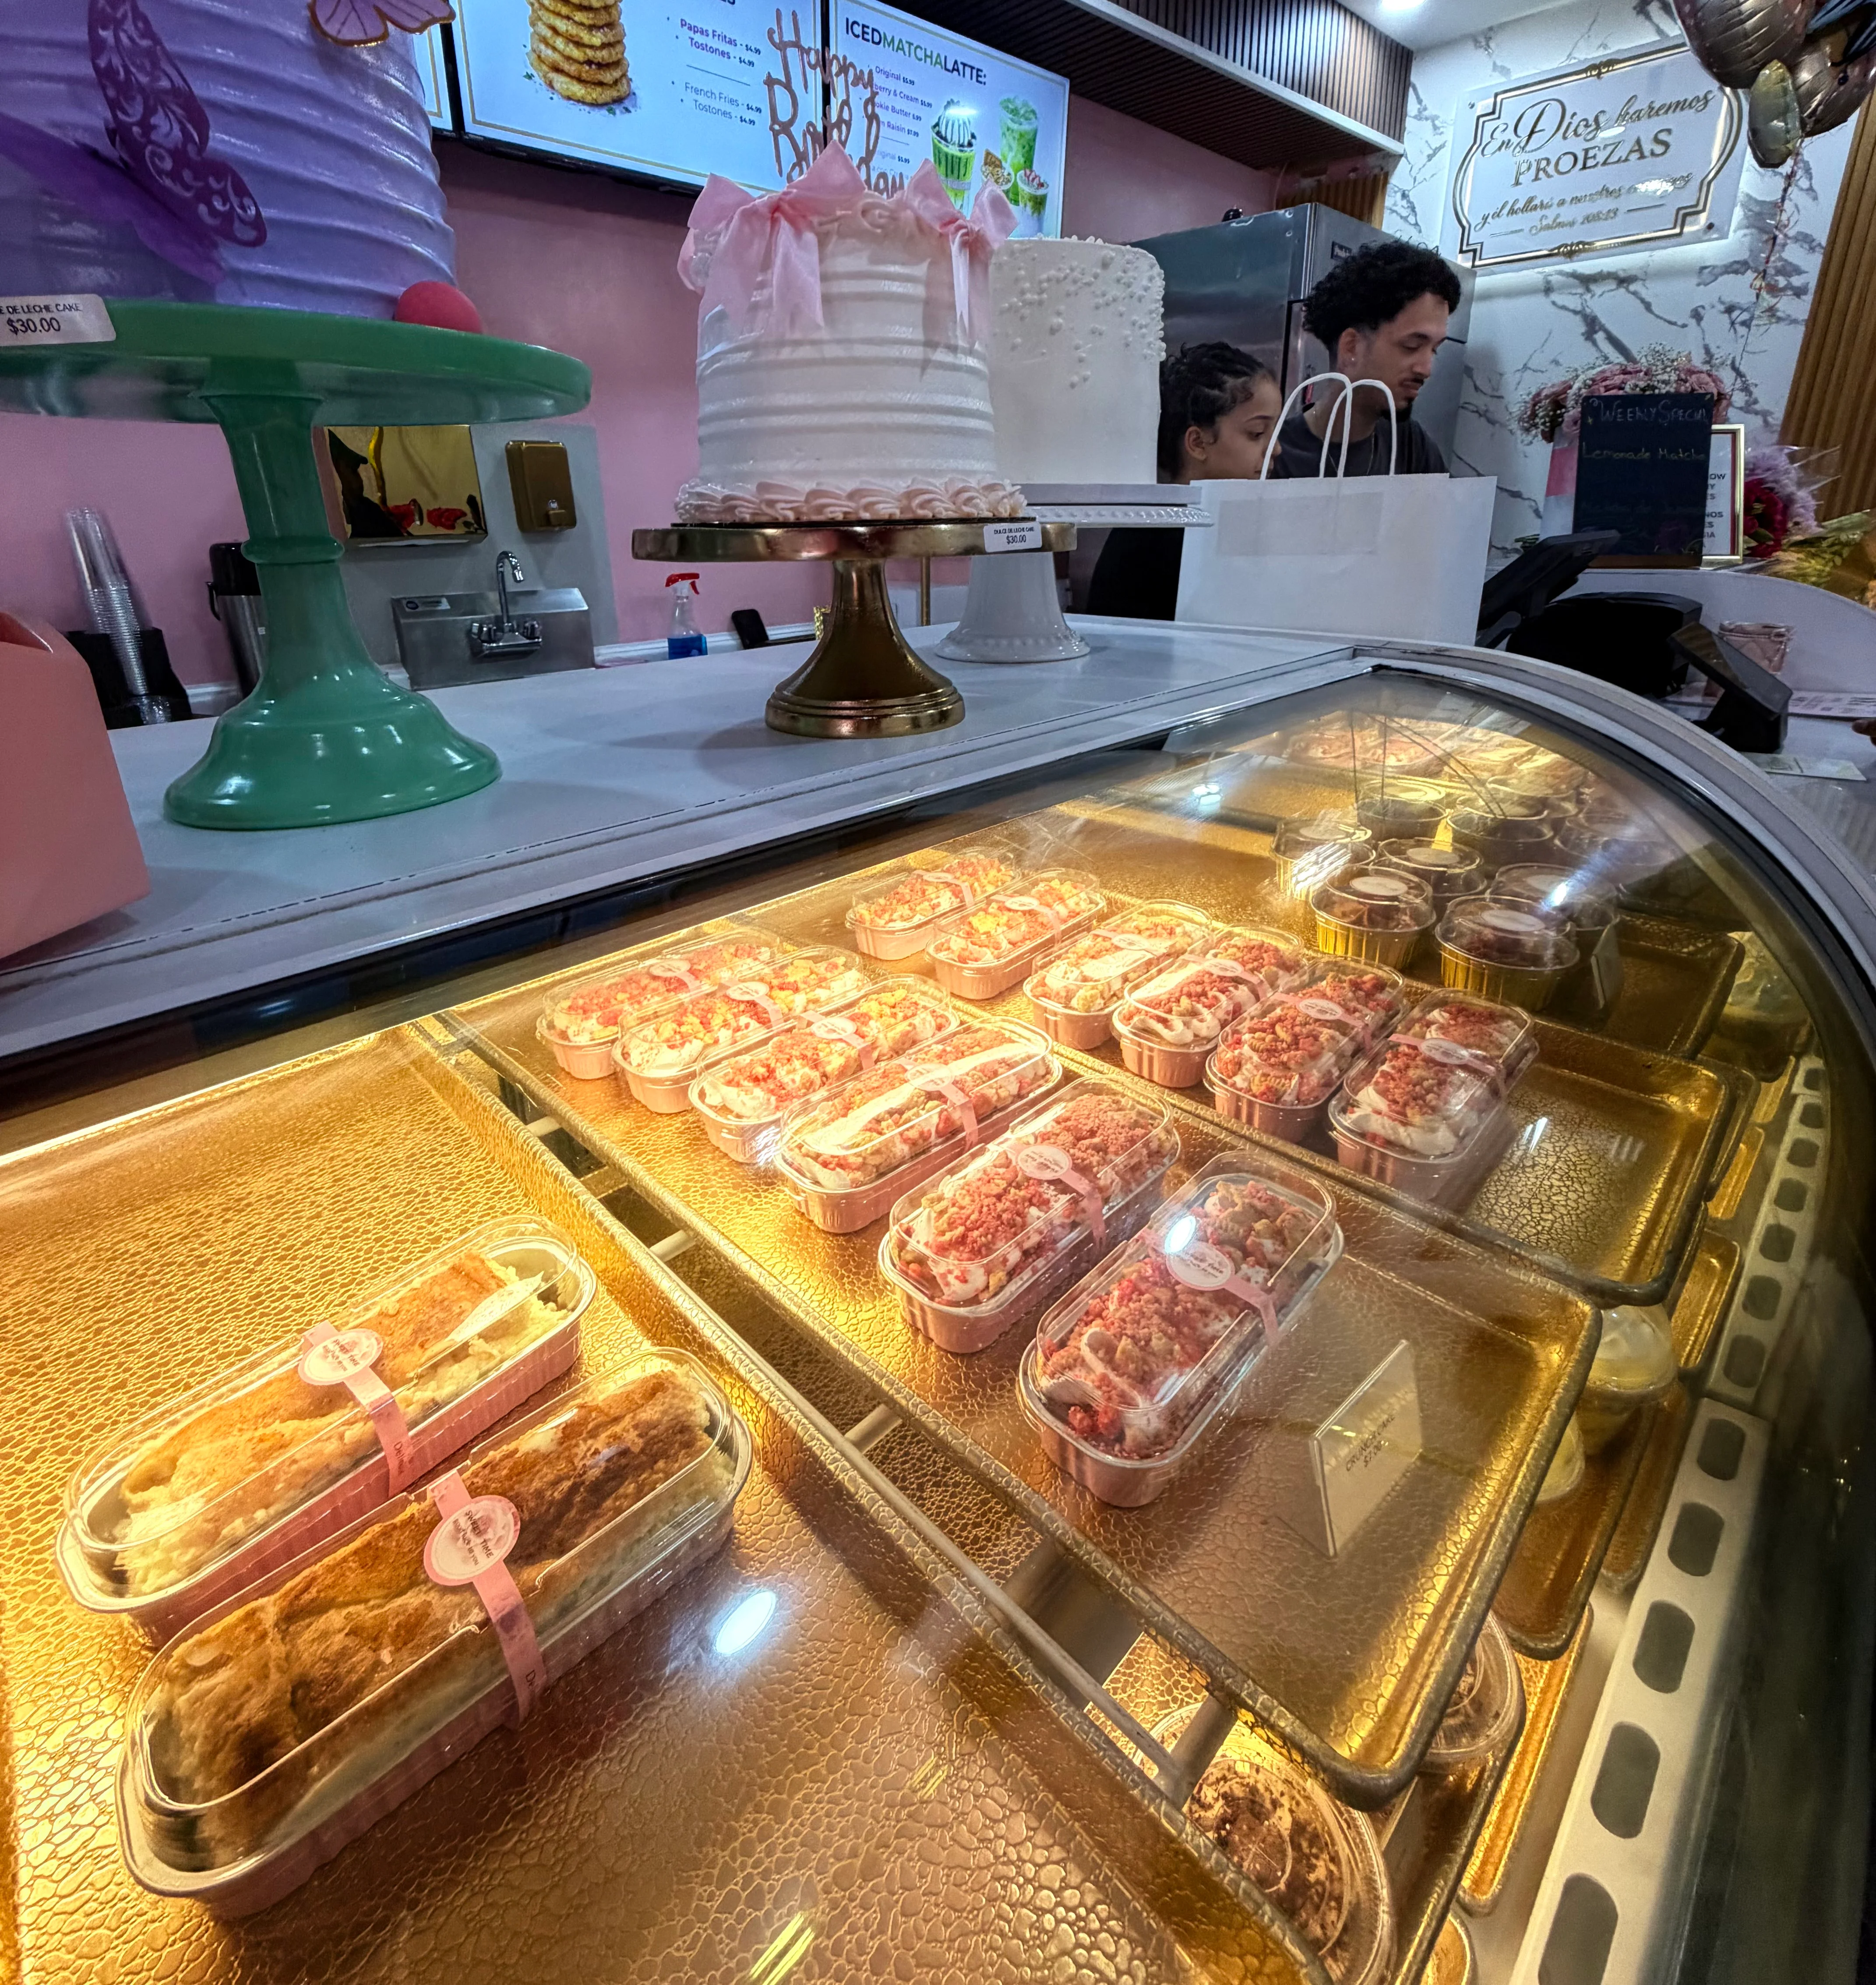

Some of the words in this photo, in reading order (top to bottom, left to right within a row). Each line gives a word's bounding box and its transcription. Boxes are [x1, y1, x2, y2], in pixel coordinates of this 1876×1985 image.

[680, 18, 709, 37] Papas
[712, 29, 737, 47] Fritas
[688, 36, 730, 60] Tostones
[875, 66, 901, 81] Original
[685, 82, 716, 100] French
[719, 92, 739, 107] Fries
[899, 91, 919, 104] Cream
[693, 99, 733, 119] Tostones
[891, 105, 911, 117] Butter
[887, 121, 906, 133] Raisin
[1481, 123, 1513, 158] En
[1512, 98, 1612, 158] Dios
[1614, 90, 1715, 127] haremos
[1511, 128, 1673, 187] PROEZAS
[1474, 212, 1491, 233] y
[1557, 198, 1566, 208] a
[55, 303, 82, 312] CAKE
[7, 317, 61, 336] $30.00
[1658, 399, 1708, 424] SPECIAL
[1582, 442, 1651, 459] Lemonade
[1658, 448, 1706, 459] Matcha
[1006, 534, 1026, 545] $30.00
[480, 1538, 494, 1558] TIME
